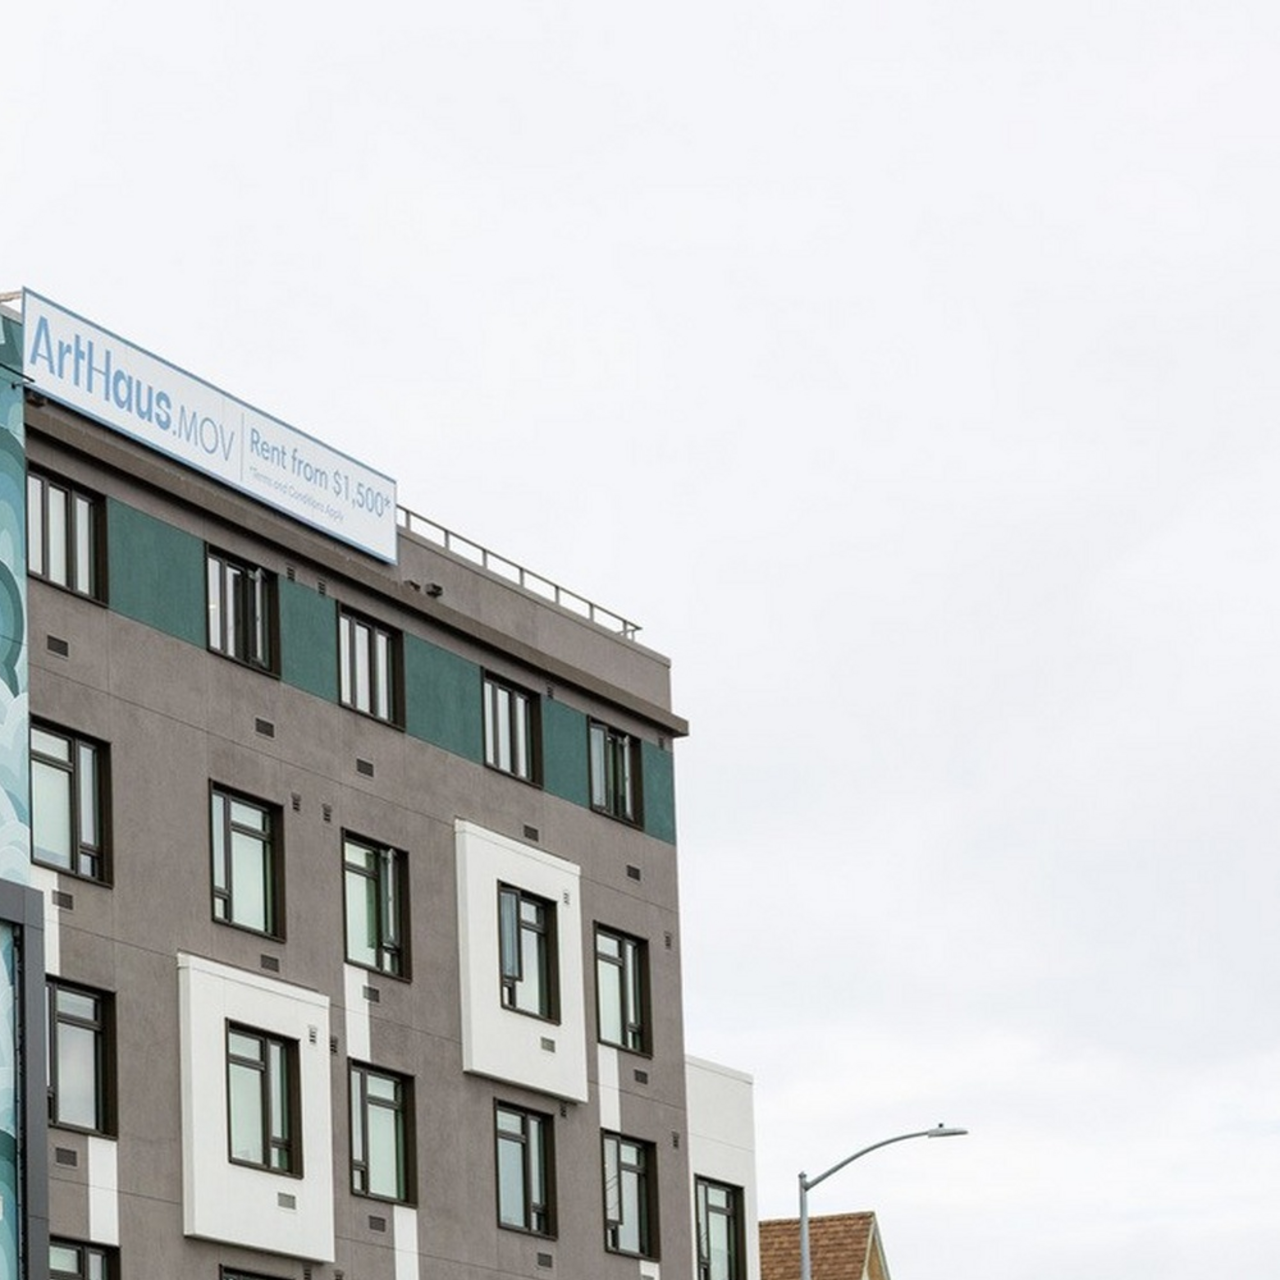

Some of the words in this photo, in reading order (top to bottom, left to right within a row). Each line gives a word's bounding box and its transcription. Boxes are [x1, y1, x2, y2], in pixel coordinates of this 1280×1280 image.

[30, 314, 235, 463] ArtHaus.MOV
[249, 428, 287, 473] Rent
[292, 448, 329, 492] from
[288, 485, 325, 513] Conditions
